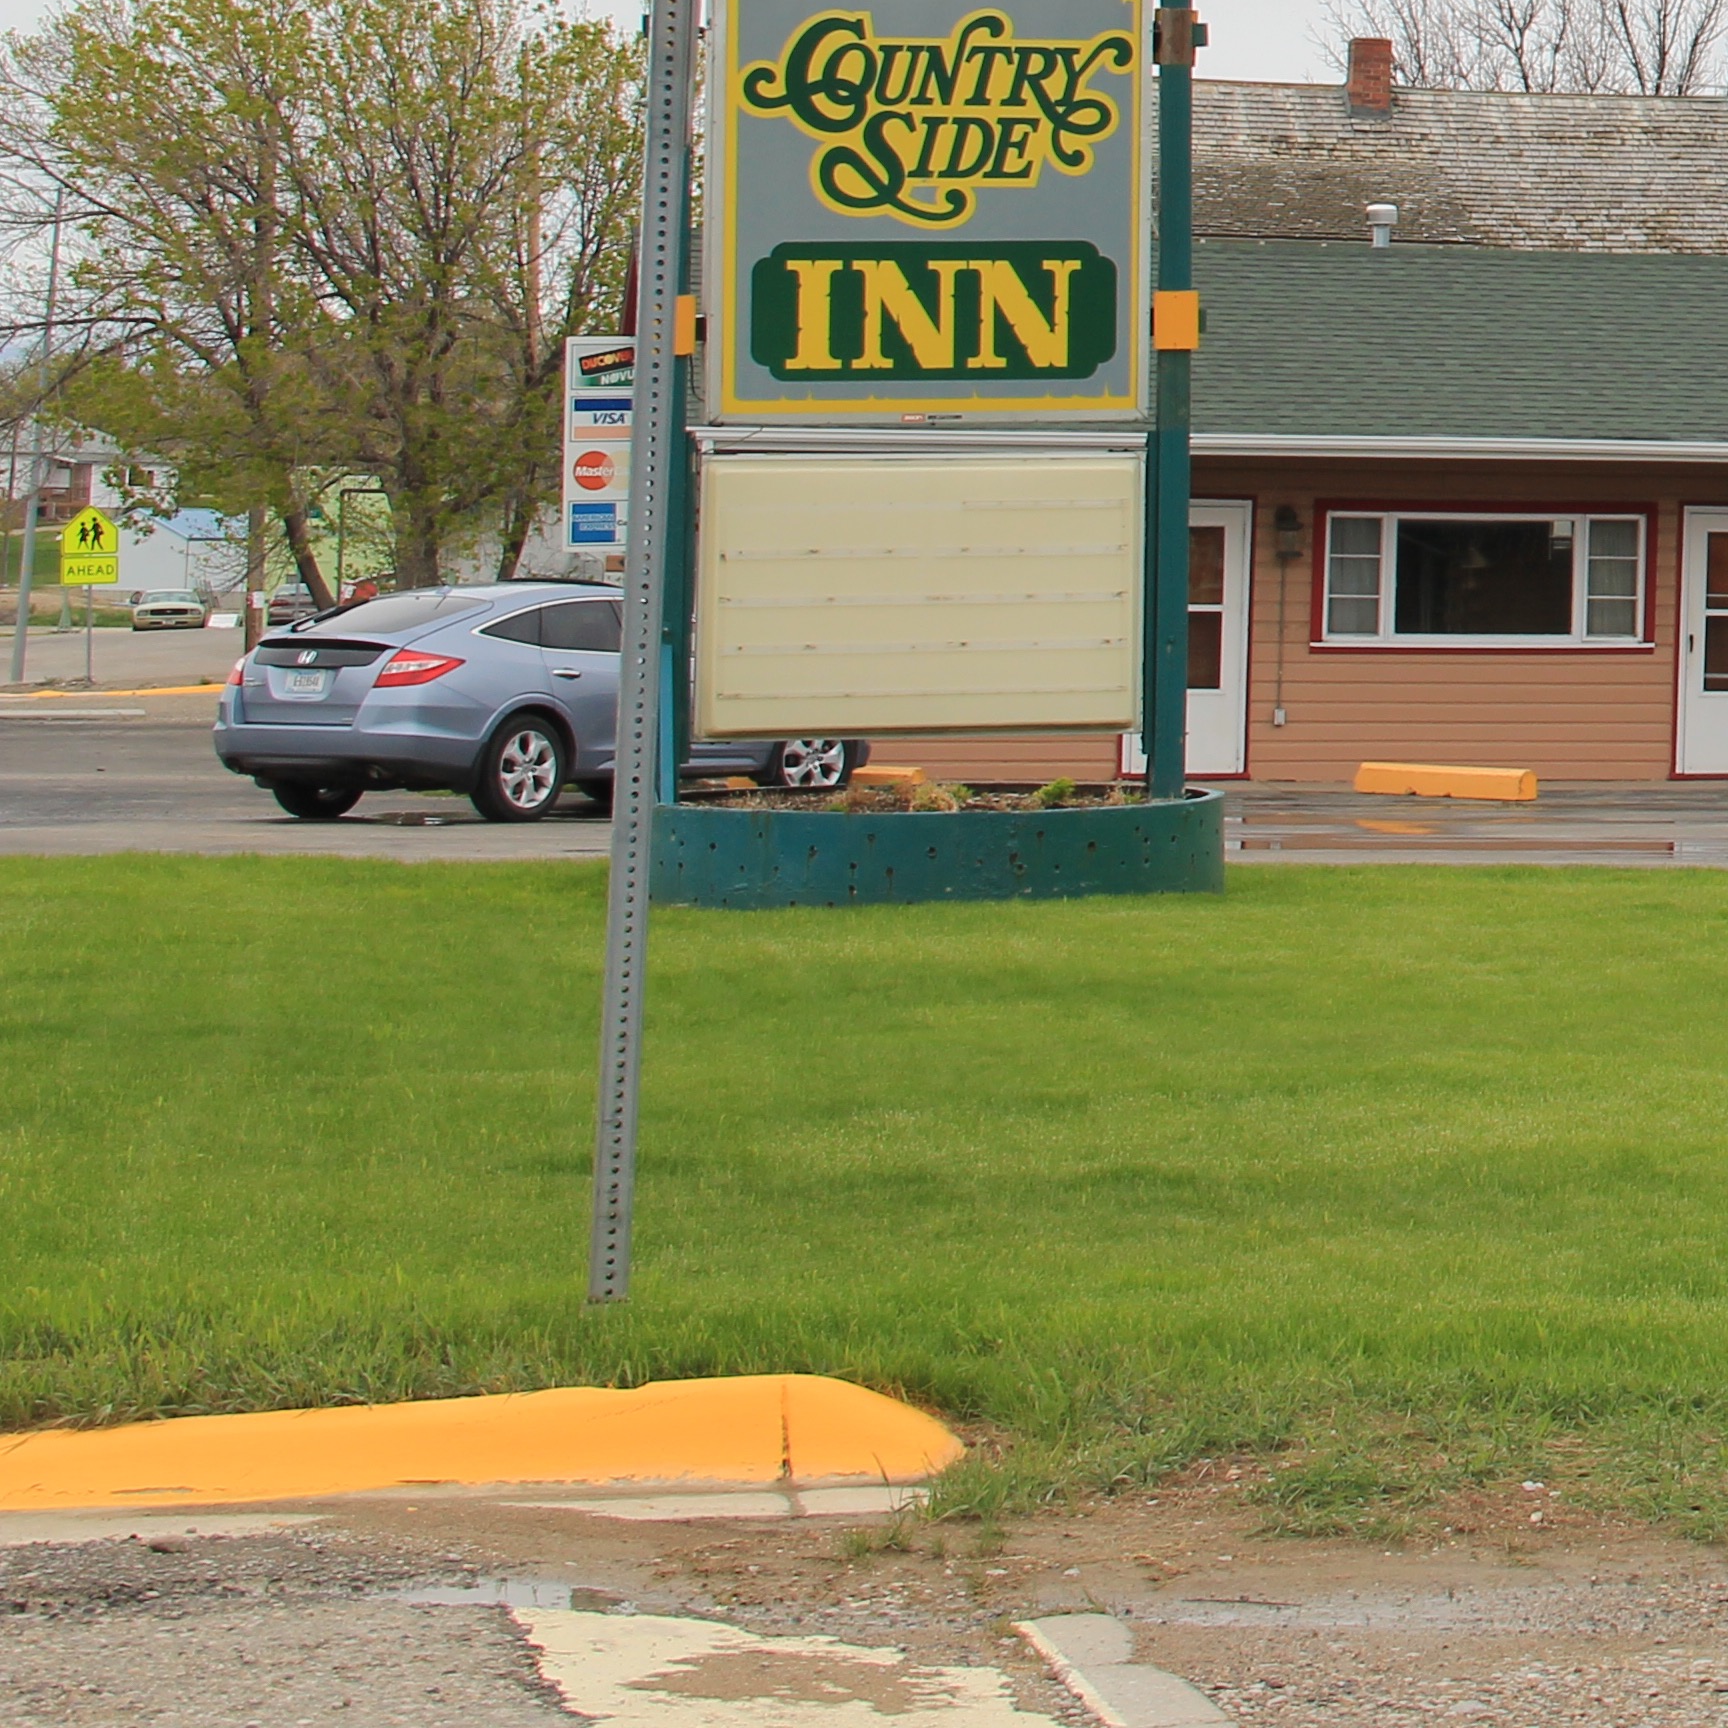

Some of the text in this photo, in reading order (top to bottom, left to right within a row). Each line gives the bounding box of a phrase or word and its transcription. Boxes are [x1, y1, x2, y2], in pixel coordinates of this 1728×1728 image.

[743, 15, 1134, 167] COUNTRY
[819, 110, 1042, 222] SIDE
[784, 258, 1083, 370] INN
[600, 370, 634, 386] NOVU
[593, 412, 626, 425] VISA
[66, 564, 115, 576] AHEAD
